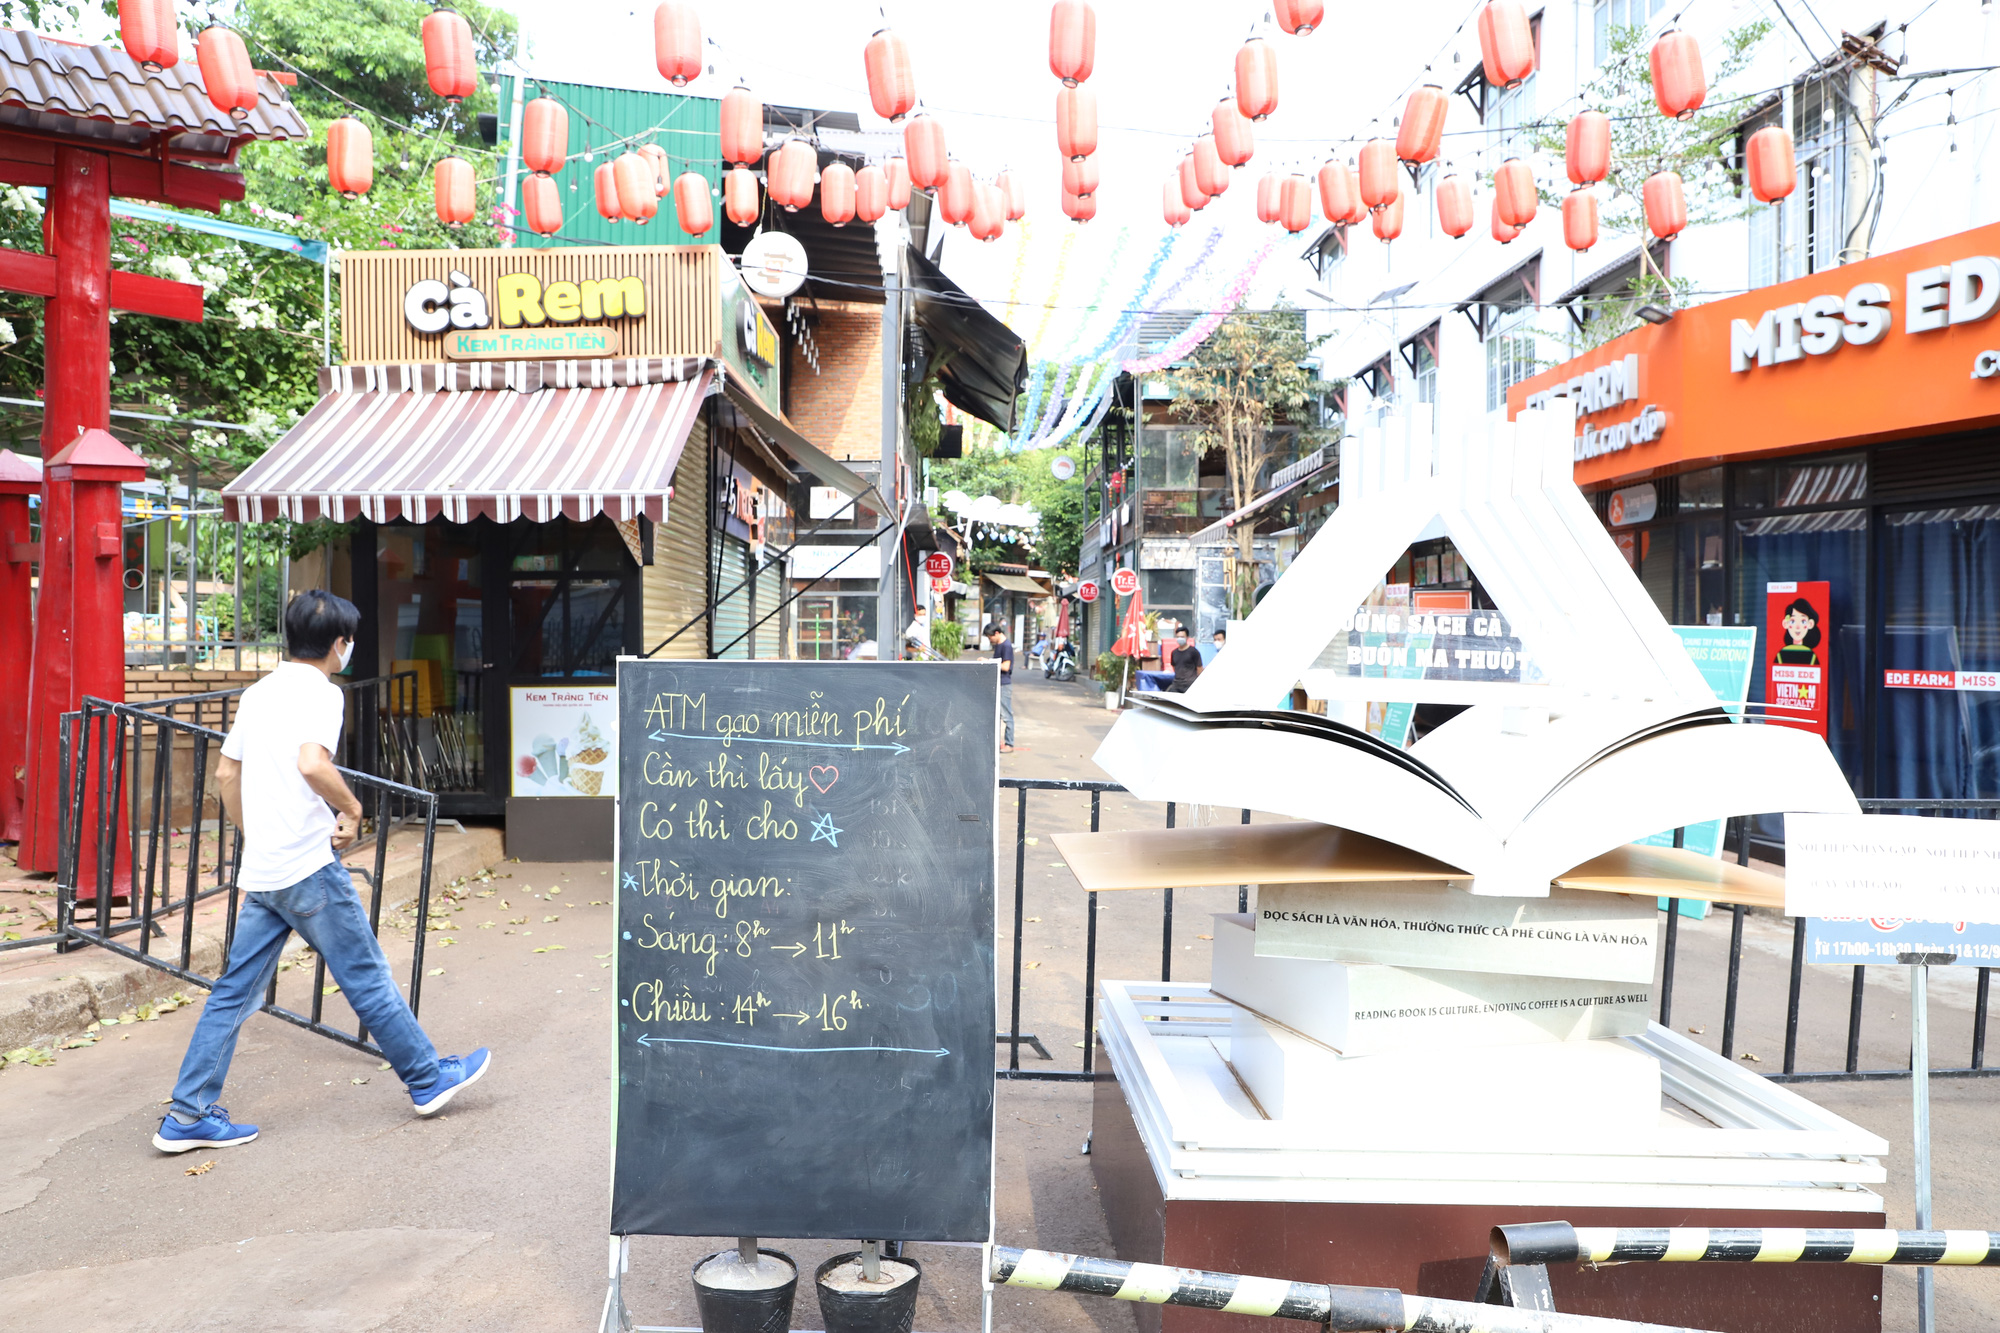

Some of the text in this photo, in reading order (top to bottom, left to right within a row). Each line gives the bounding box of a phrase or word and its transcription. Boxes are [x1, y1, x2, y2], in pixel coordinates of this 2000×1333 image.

[404, 269, 646, 334] Cà Rem
[1731, 283, 1892, 373] MISS
[457, 332, 605, 353] KEM TRÀNG TIỀN
[1970, 349, 2000, 379] .C
[1600, 422, 1630, 454] CAO
[1630, 405, 1666, 444] CẤP
[928, 559, 949, 569] Tr.E
[1082, 587, 1096, 595] Tr.E
[1116, 575, 1135, 585] Tr.E
[1408, 611, 1467, 636] SÁCH
[1474, 613, 1502, 637] CÀ
[1346, 642, 1408, 666] BUÔN
[1415, 648, 1449, 668] MA
[1710, 647, 1748, 662] CORONA
[1774, 670, 1814, 679] MISS EDE
[1886, 672, 1910, 685] EDE
[1962, 675, 1997, 687] MISS
[526, 692, 547, 702] KEM
[1776, 683, 1816, 700] VIETNM
[644, 690, 911, 751] ATM gạo miễn phí
[643, 751, 809, 807] Cần thì lấy
[640, 798, 798, 840] Có thì cho
[636, 858, 699, 900] Thời
[1263, 910, 1290, 923] ĐỌC
[1292, 911, 1323, 924] SÁCH
[1326, 912, 1341, 925] LÀ
[1343, 915, 1368, 927] VĂN
[1403, 921, 1455, 934] THƯỞNG
[1457, 924, 1490, 936] THỨC
[1492, 925, 1509, 937] CÀ
[1512, 927, 1534, 939] PHÊ
[1537, 929, 1572, 941] CŨNG
[1575, 930, 1590, 942] LÀ
[1592, 932, 1618, 944] VĂN
[1621, 934, 1648, 946] HÓA
[1354, 1010, 1397, 1021] READING
[1399, 1008, 1427, 1018] BOOK
[1428, 1007, 1437, 1016] IS
[1483, 1001, 1527, 1014] ENJOYING
[1528, 999, 1559, 1010] COFFEE
[1560, 999, 1568, 1008] IS
[1569, 998, 1576, 1007] A
[1577, 996, 1614, 1007] CULTURE
[1615, 995, 1626, 1004] AS
[1627, 993, 1648, 1003] WELL
